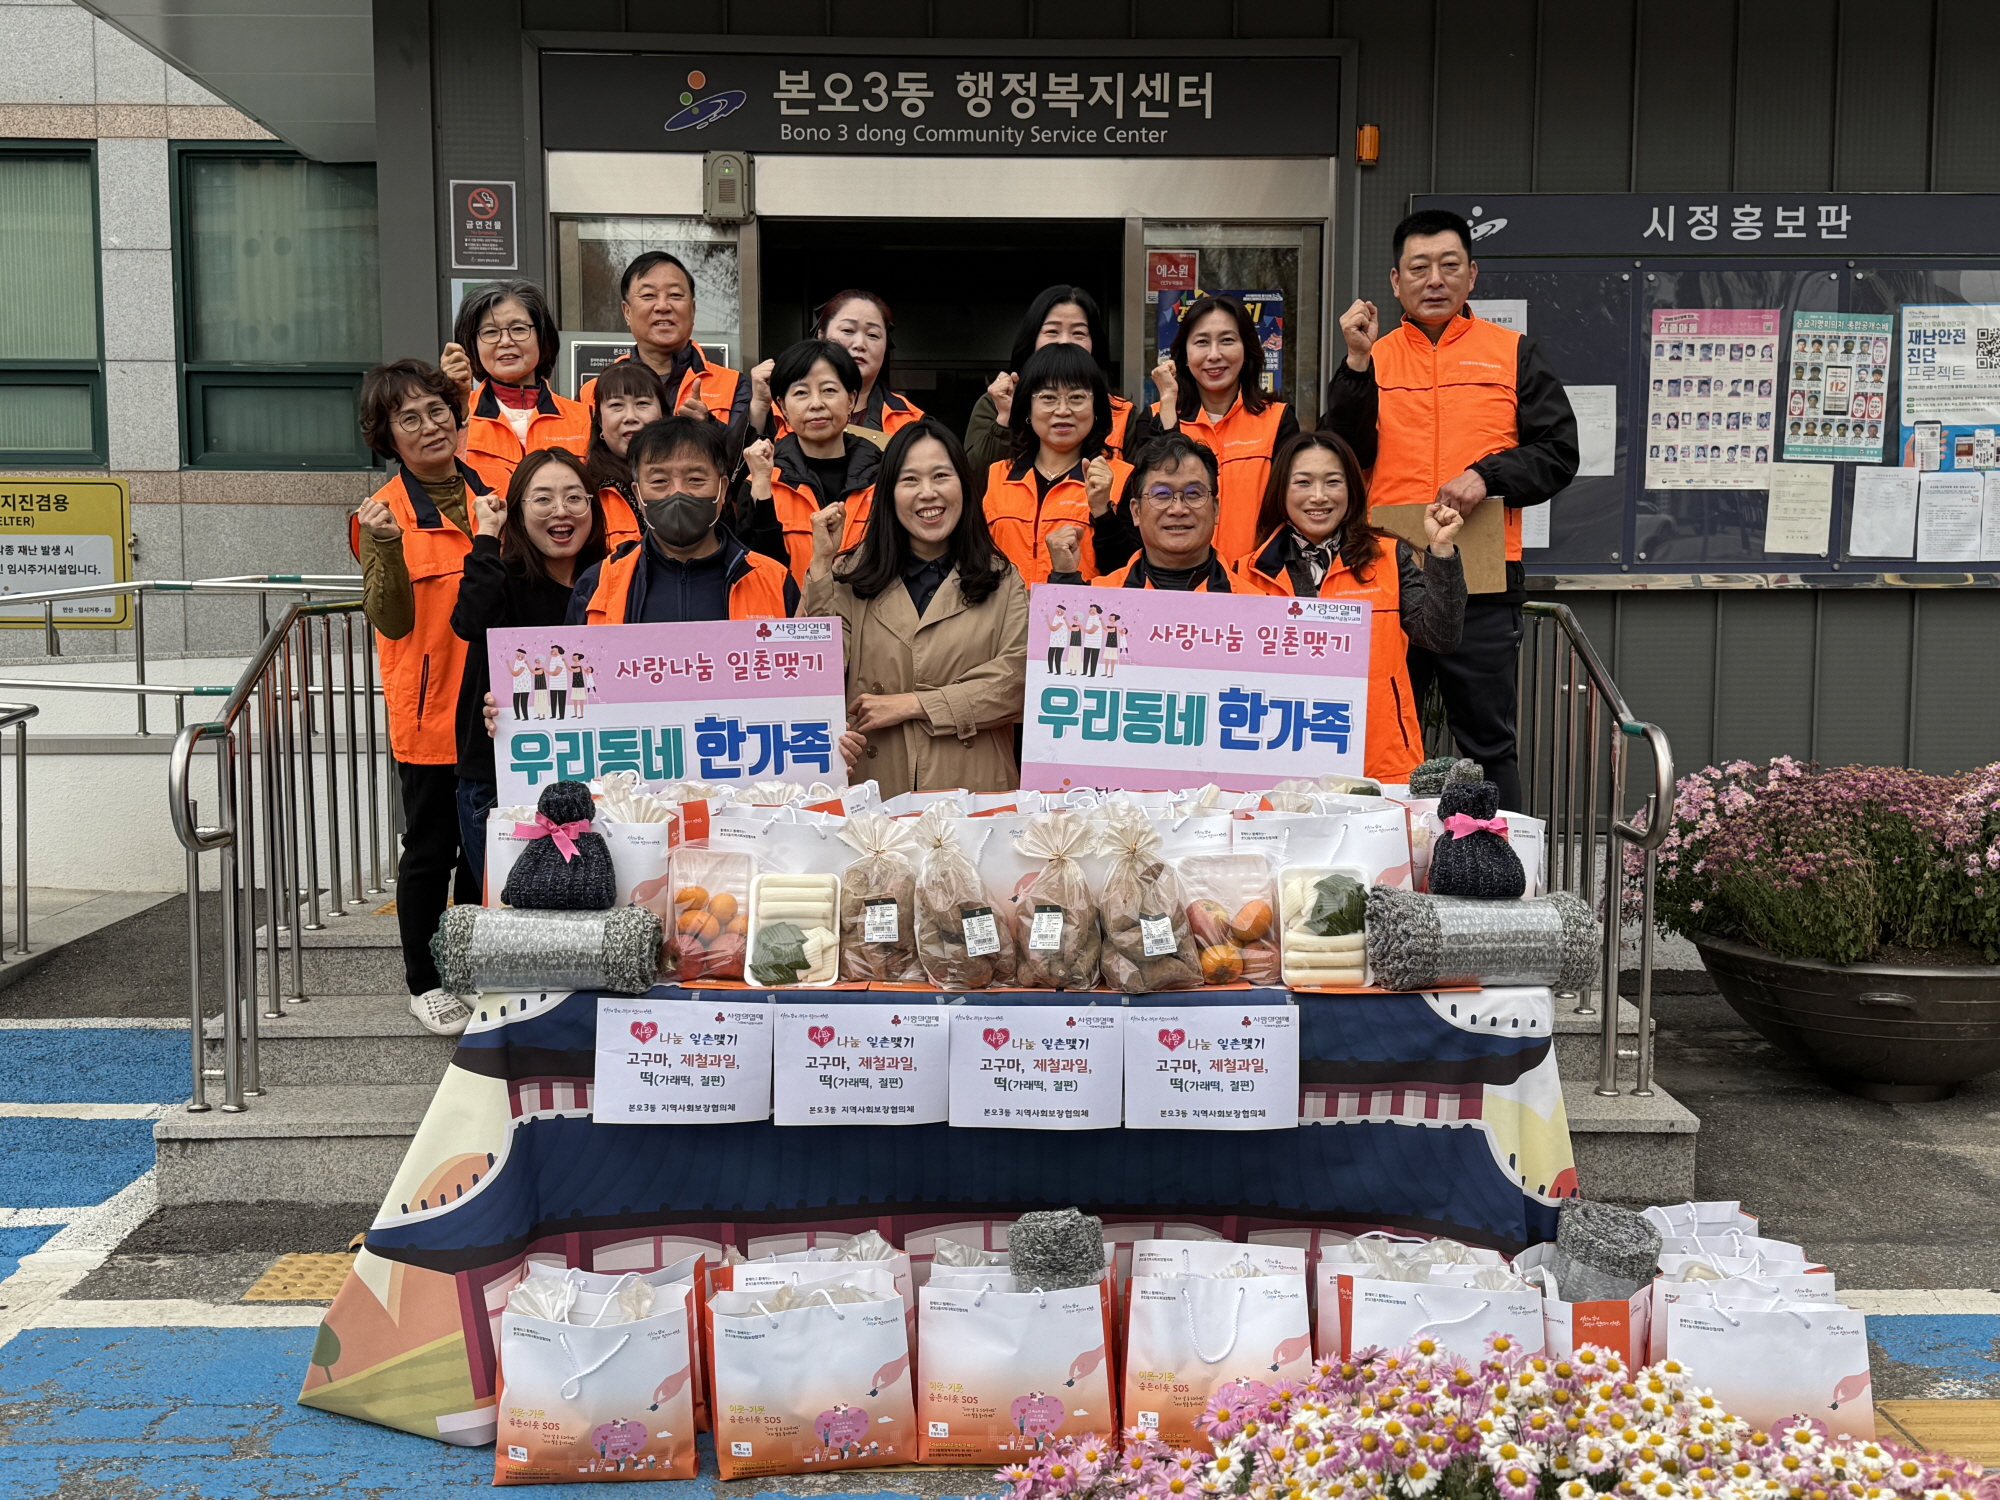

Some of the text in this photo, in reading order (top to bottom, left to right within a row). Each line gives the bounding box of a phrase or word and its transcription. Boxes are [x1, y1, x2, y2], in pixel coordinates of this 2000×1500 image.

[773, 70, 1214, 121] 본오3동 행정복지센터
[780, 124, 1168, 147] Bono 3 dong Community Service Center
[1643, 204, 1852, 242] 시정홍보판
[1156, 264, 1188, 278] 에스원
[1907, 329, 1966, 345] 재난안전
[1907, 348, 1937, 364] 진단
[1907, 366, 1966, 381] 프로젝트
[1829, 381, 1847, 393] 112
[1, 494, 70, 512] 지진겸용
[18, 545, 38, 556] 재난
[41, 545, 61, 556] 발생
[64, 545, 74, 556] 시
[7, 564, 101, 575] 임시주거시설입니다.
[1306, 603, 1361, 616] 사랑의열매
[775, 623, 831, 635] 사랑의열매
[1149, 623, 1351, 659] 사랑나눔 일촌맺기
[616, 650, 824, 685] 사랑나눔 일촌맺기
[1037, 686, 1351, 755] 우리동네 한가족
[510, 715, 832, 785] 우리동네 한가족
[635, 1025, 737, 1046] 사랑 나눔 일촌맺기
[812, 1029, 915, 1050] 사랑 나눔 일촌맺기
[987, 1032, 1090, 1051] 사랑 나눔 일촌맺기
[1162, 1032, 1266, 1051] 사랑 나눔 일촌맺기
[627, 1053, 740, 1070] 고구마, 제철과일,
[805, 1055, 918, 1072] 고구마, 제철과일,
[980, 1058, 1093, 1075] 고구마, 제철과일,
[1156, 1058, 1269, 1075] 고구마, 제철과일,
[640, 1071, 725, 1088] 떡(가래떡, 절편)
[819, 1074, 903, 1090] 떡(가래떡, 절편)
[994, 1077, 1078, 1092] 떡(가래떡, 절편)
[1170, 1077, 1255, 1093] 떡(가래떡, 절편)
[628, 1103, 736, 1114] 본오3동 지역사회보장협의체
[809, 1105, 915, 1115] 본오3동 지역사회보장협의체
[983, 1108, 1089, 1118] 본오3동 지역사회보장협의체
[1160, 1108, 1266, 1118] 본오3동 지역사회보장협의체
[1173, 1384, 1189, 1393] SOS
[962, 1395, 979, 1404] SOS
[542, 1421, 560, 1431] SOS
[764, 1416, 782, 1424] SOS
